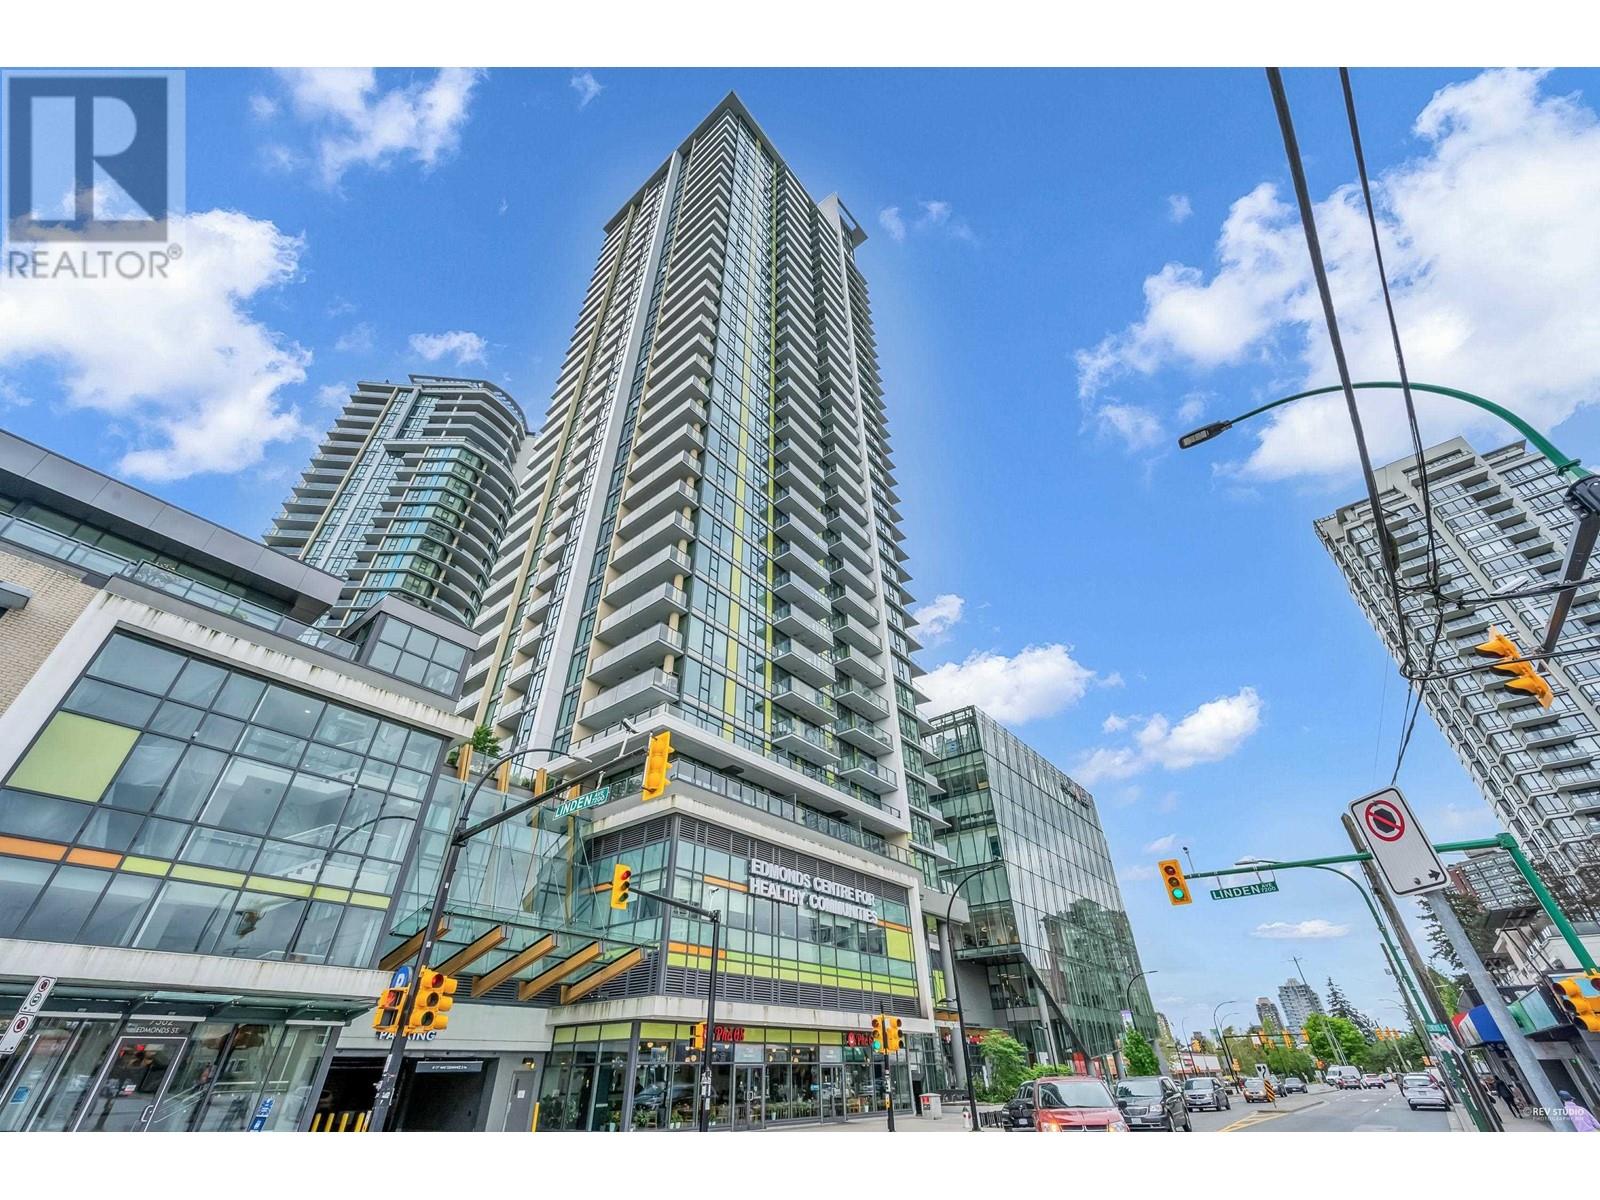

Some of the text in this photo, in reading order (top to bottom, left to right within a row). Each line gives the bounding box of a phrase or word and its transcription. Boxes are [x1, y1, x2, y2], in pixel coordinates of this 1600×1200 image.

[555, 792, 593, 817] LINDEN
[751, 858, 876, 906] EDMONDS CENTRE FOR
[1212, 884, 1260, 899] LINDEN
[750, 877, 878, 924] HEALTHY COMMUNITIES
